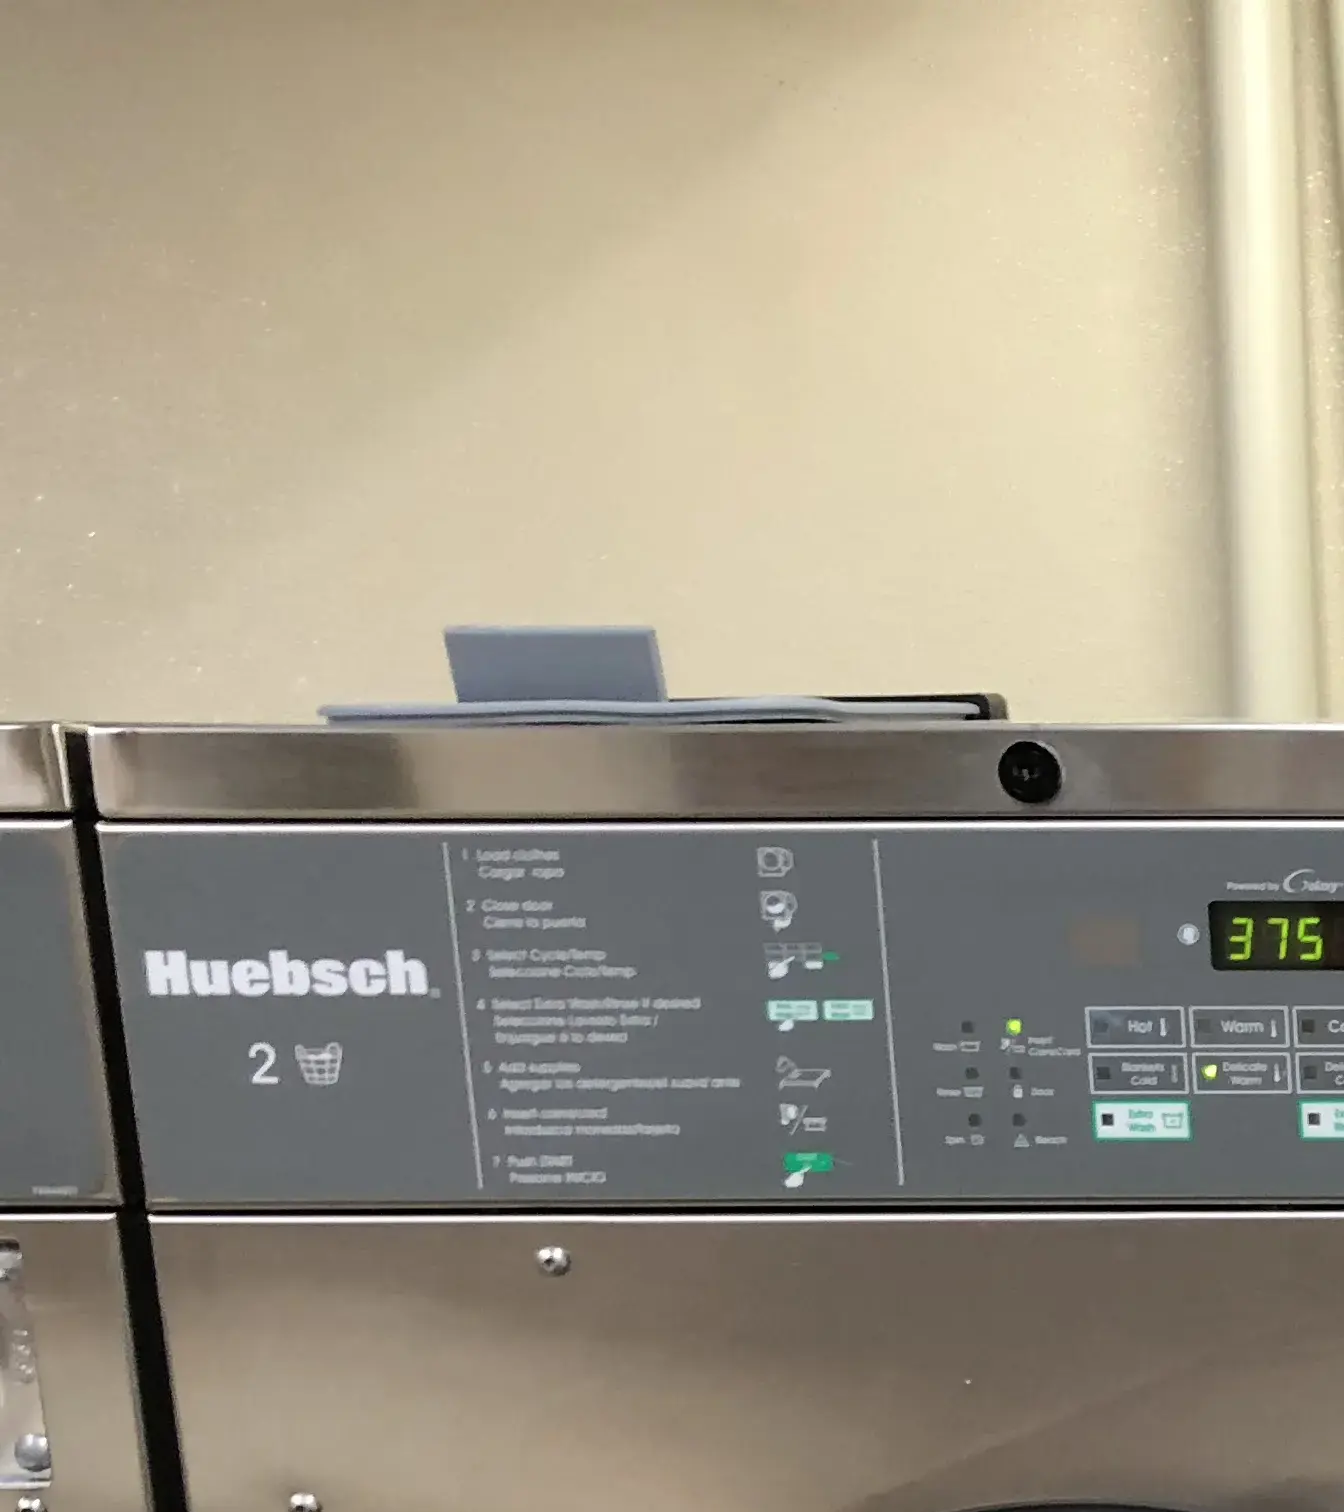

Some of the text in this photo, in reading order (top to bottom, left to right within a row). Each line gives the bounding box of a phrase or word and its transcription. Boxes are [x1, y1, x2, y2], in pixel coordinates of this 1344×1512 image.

[1228, 917, 1324, 961] 375
[144, 949, 429, 997] Huebsch
[1128, 1019, 1153, 1033] Hot
[1220, 1020, 1264, 1033] Warm
[248, 1041, 280, 1085] 2
[1222, 1062, 1268, 1073] Delicate
